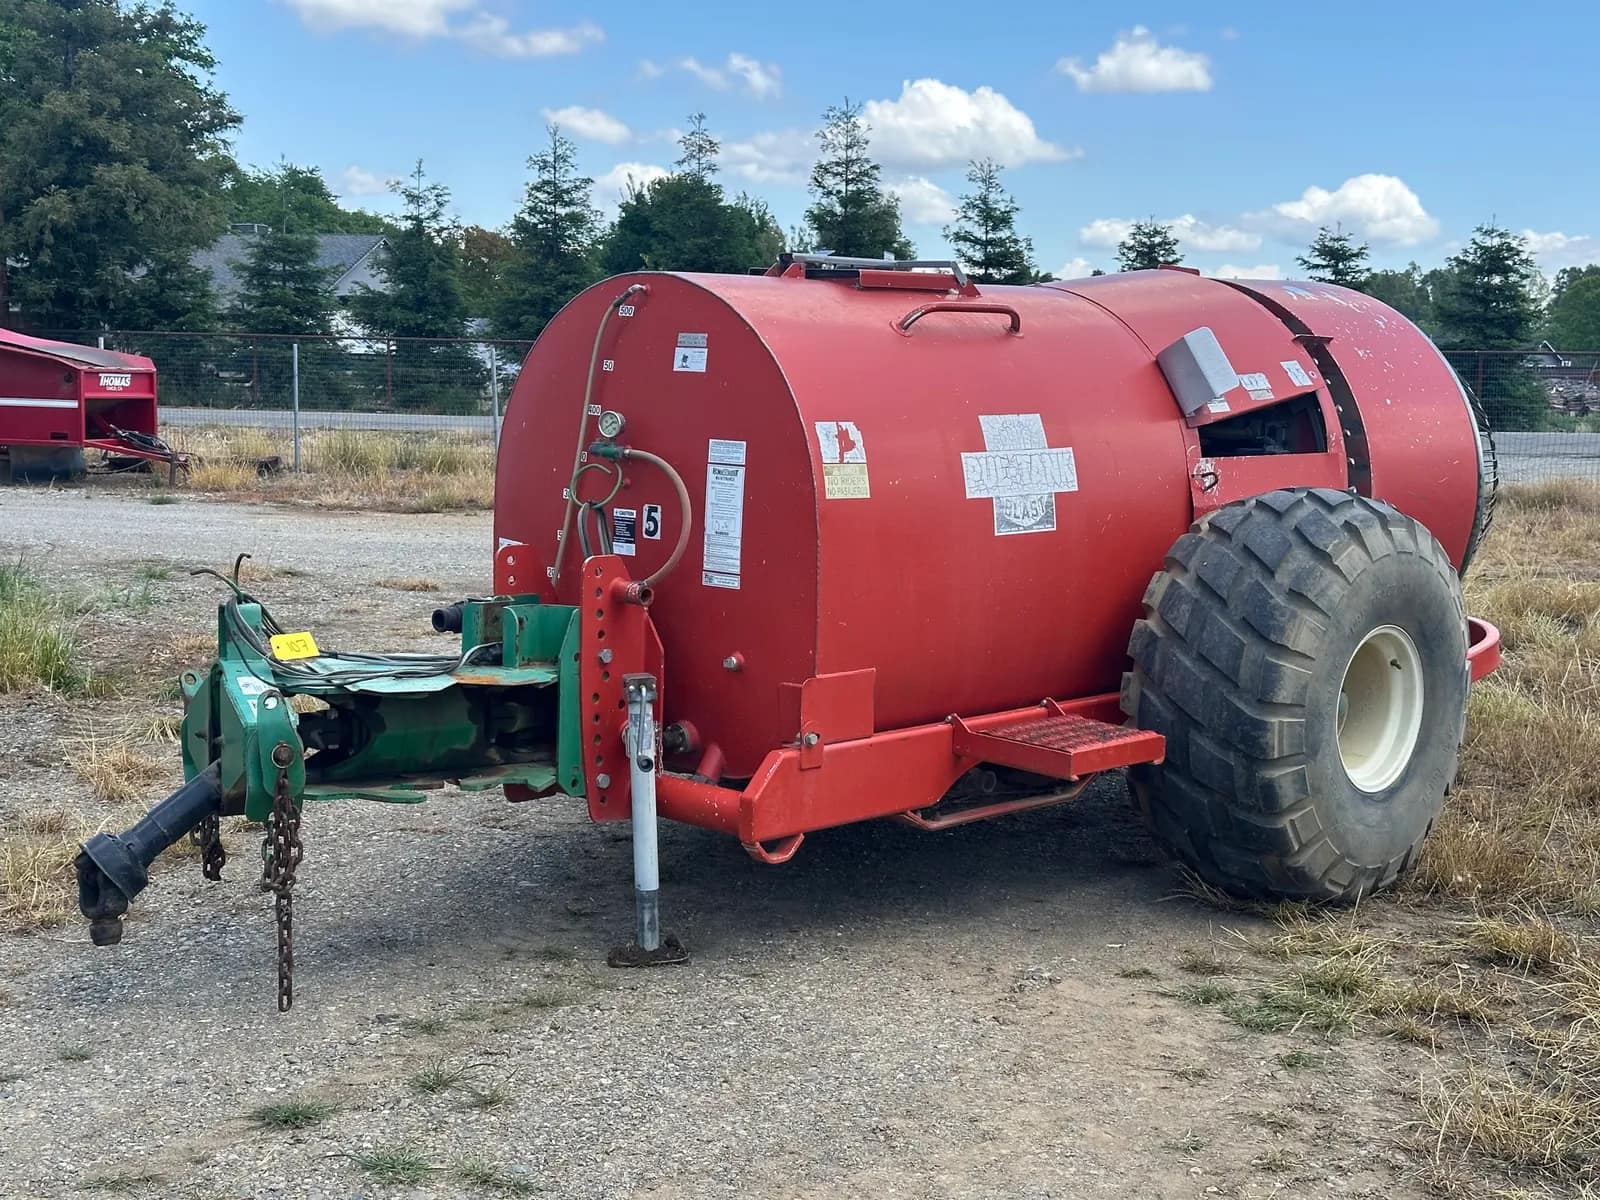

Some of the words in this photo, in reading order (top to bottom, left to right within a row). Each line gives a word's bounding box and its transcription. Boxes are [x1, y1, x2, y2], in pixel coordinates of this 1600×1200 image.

[620, 306, 634, 315] 500
[99, 373, 131, 387] THOMAS
[645, 506, 659, 537] 5
